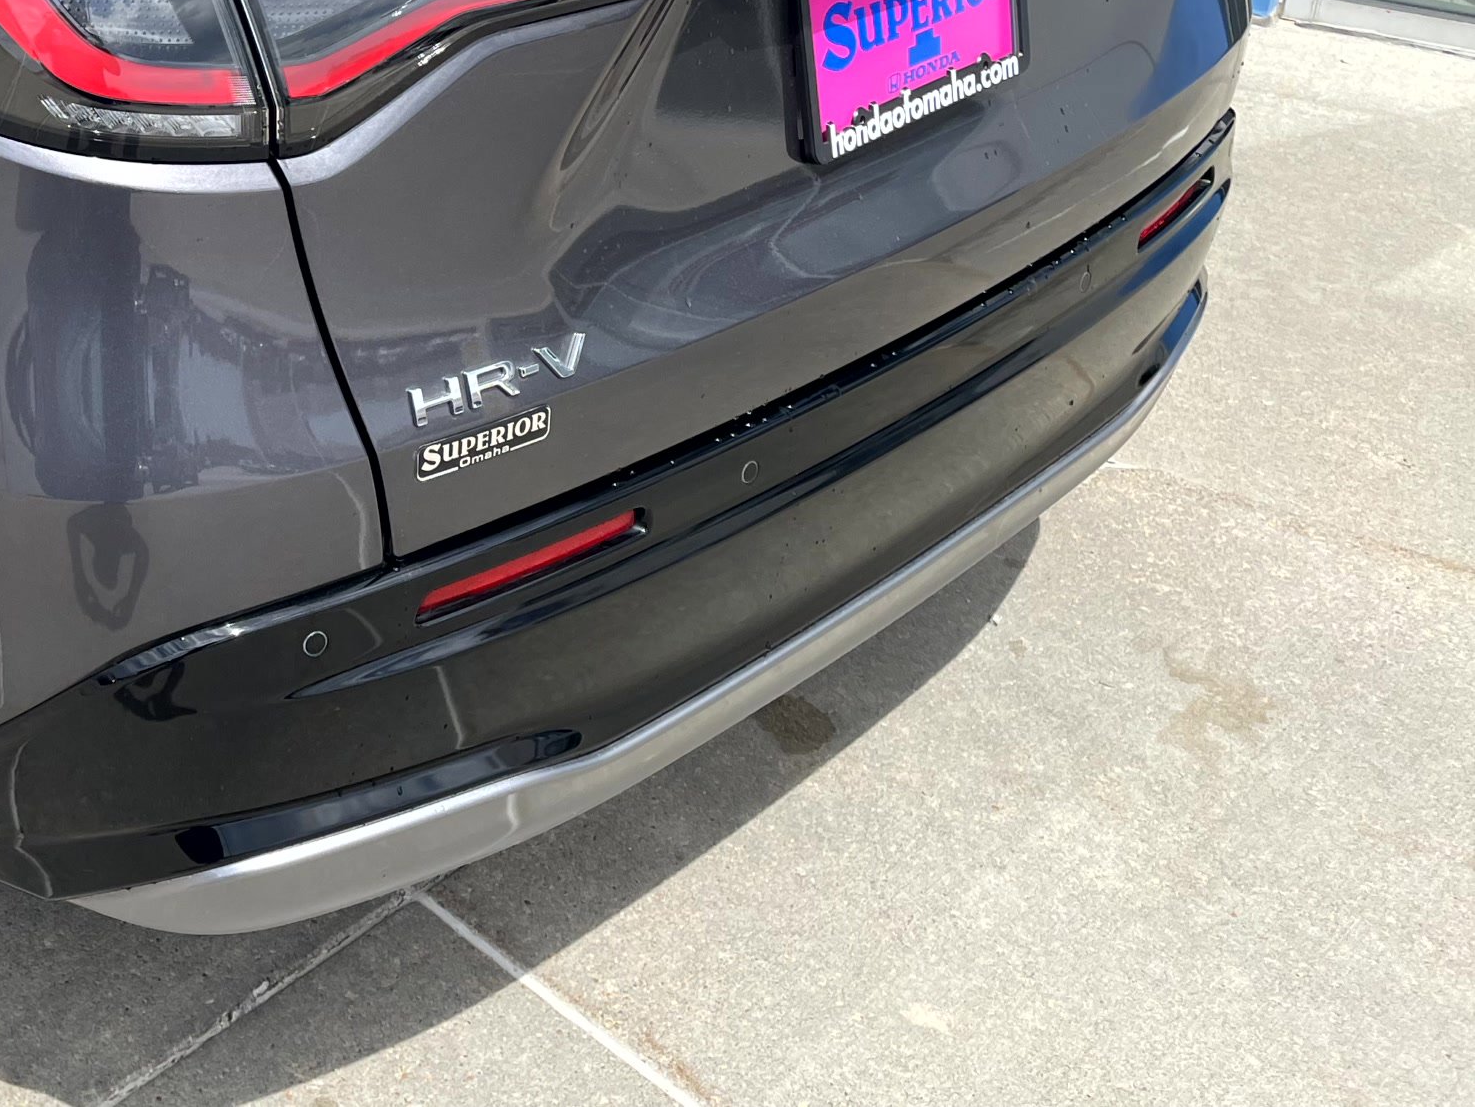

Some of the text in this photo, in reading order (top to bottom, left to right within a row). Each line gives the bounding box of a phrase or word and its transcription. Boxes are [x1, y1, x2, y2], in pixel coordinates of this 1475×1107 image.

[903, 51, 960, 84] HONDA
[828, 54, 1020, 159] hondaofomaha.com
[405, 332, 586, 428] HR-V
[420, 411, 546, 472] SUPERIOR
[459, 444, 510, 468] Omaha
